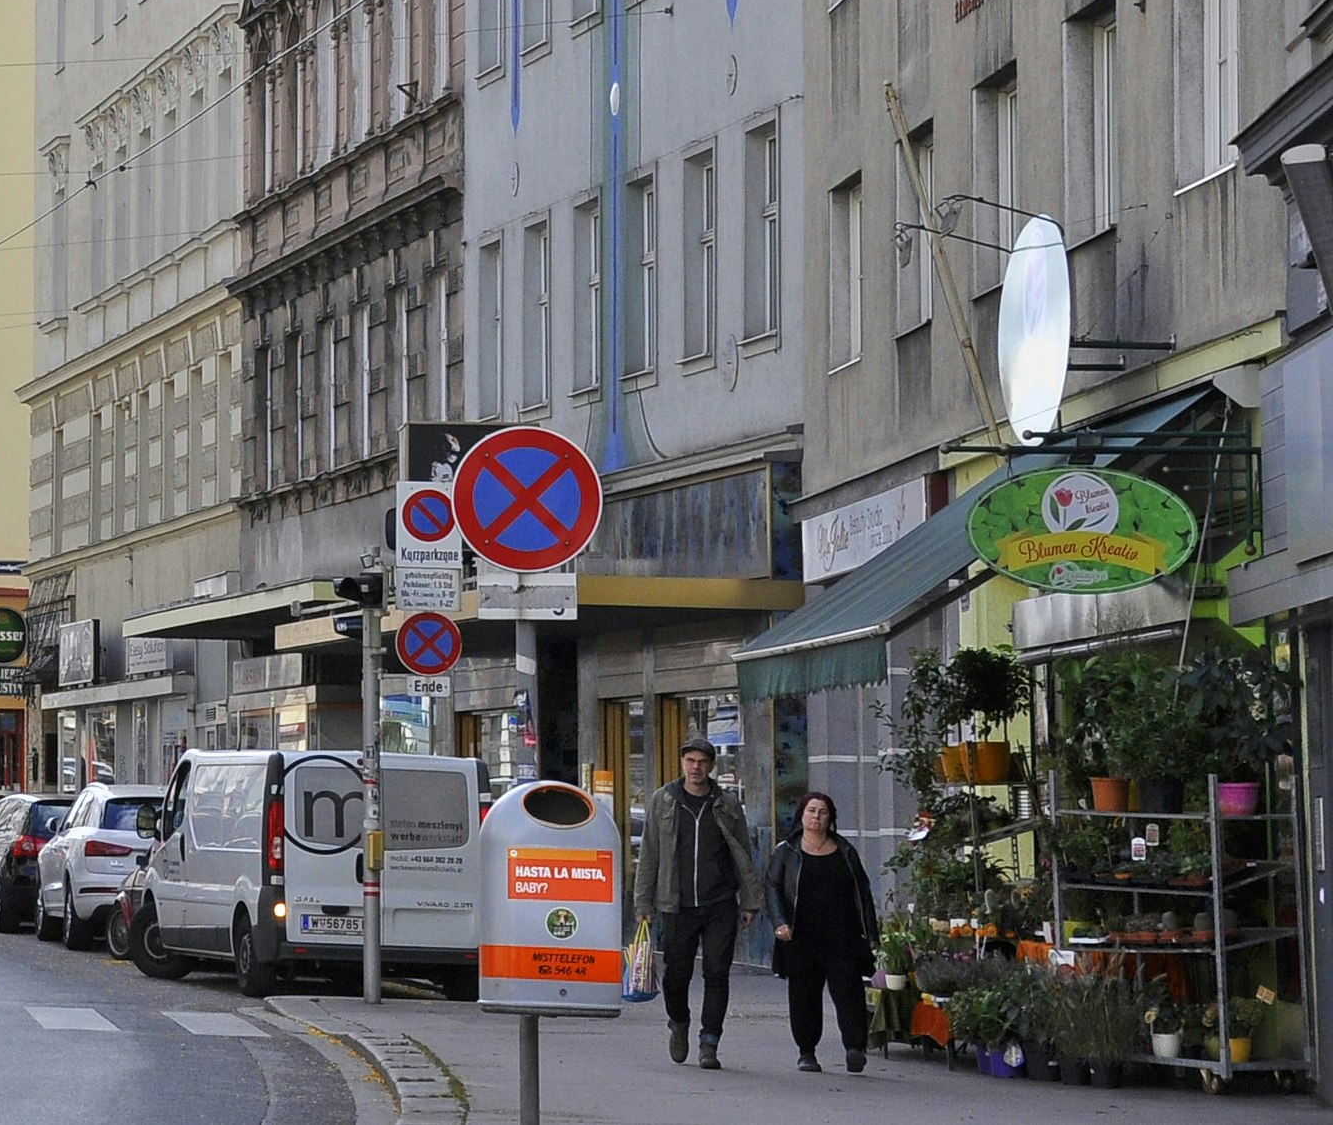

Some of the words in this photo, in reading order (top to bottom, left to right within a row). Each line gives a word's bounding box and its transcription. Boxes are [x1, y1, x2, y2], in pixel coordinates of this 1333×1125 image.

[1075, 488, 1110, 505] Blumen
[400, 546, 460, 564] Kurzparkzone
[1019, 538, 1077, 564] Blumen
[1081, 535, 1138, 563] Kreativ
[414, 680, 443, 693] Ende
[515, 865, 552, 878] HASTA
[554, 867, 570, 879] LA
[571, 868, 607, 883] MISTA,
[514, 881, 549, 894] BABY?
[532, 952, 596, 965] MISTTELEFON
